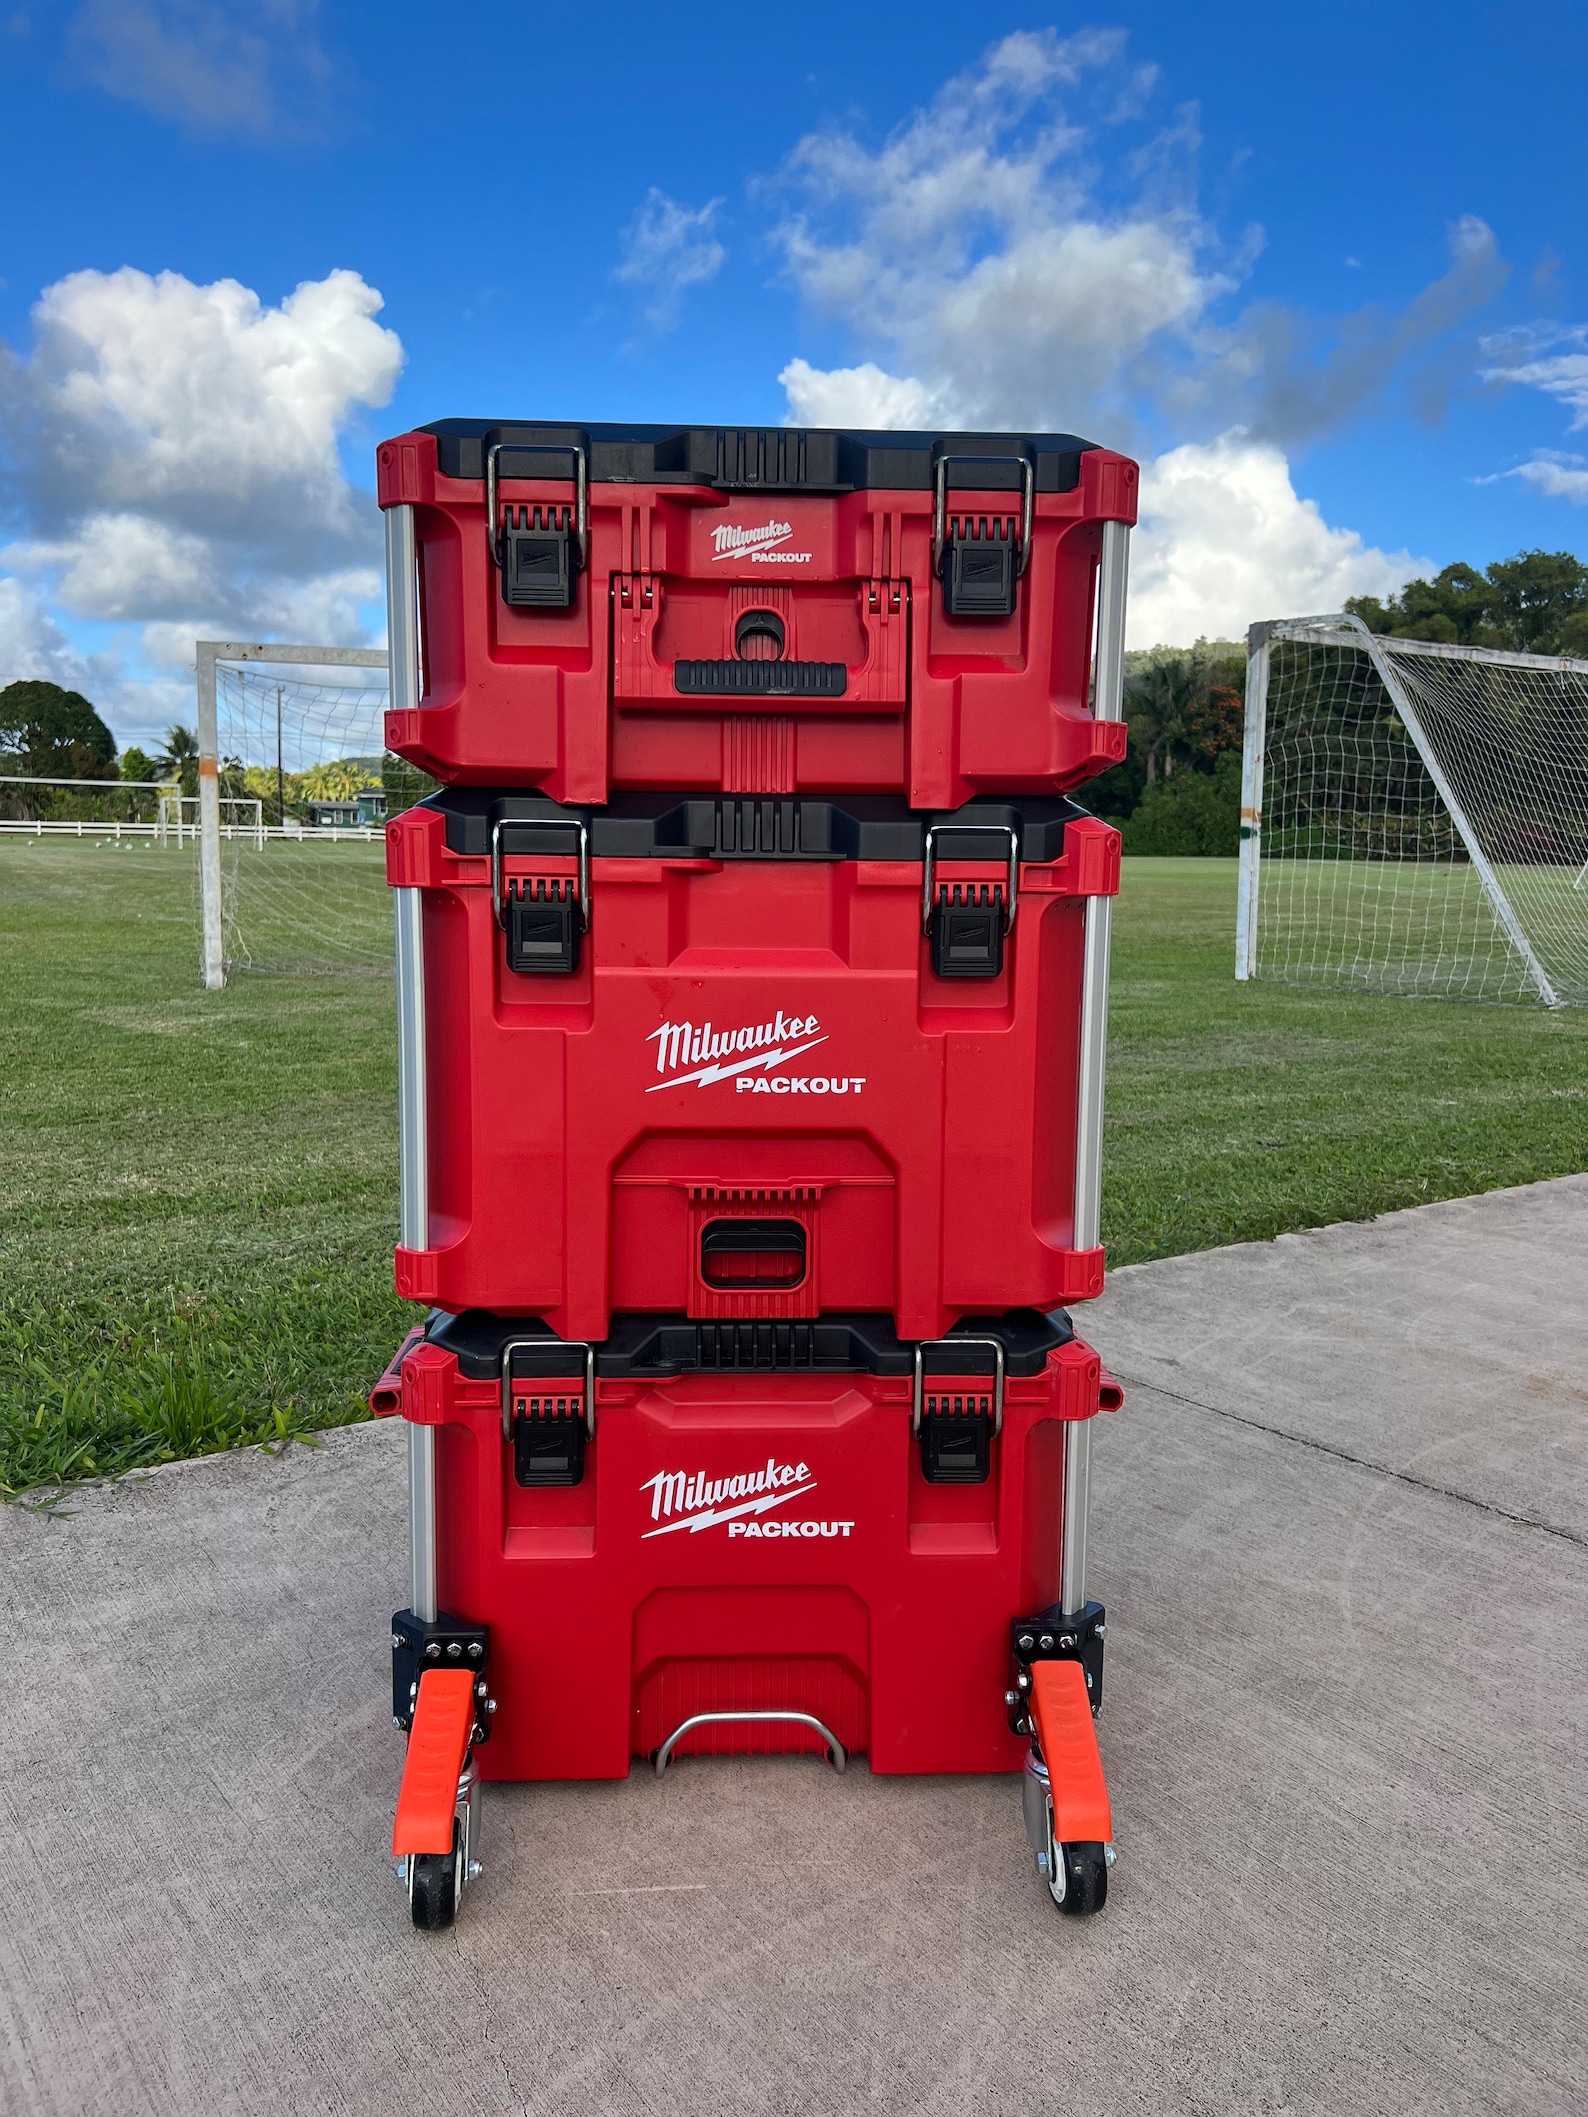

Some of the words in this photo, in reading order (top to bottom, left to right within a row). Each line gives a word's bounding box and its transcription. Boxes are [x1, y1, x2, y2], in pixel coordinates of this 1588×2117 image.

[710, 520, 793, 553] Milwaukee
[751, 553, 812, 563] PACKOUT
[645, 1010, 821, 1074] Milwaukee
[736, 1077, 867, 1093] PACKOUT
[639, 1458, 812, 1521] Milwaukee
[728, 1521, 855, 1537] PACKOUT
